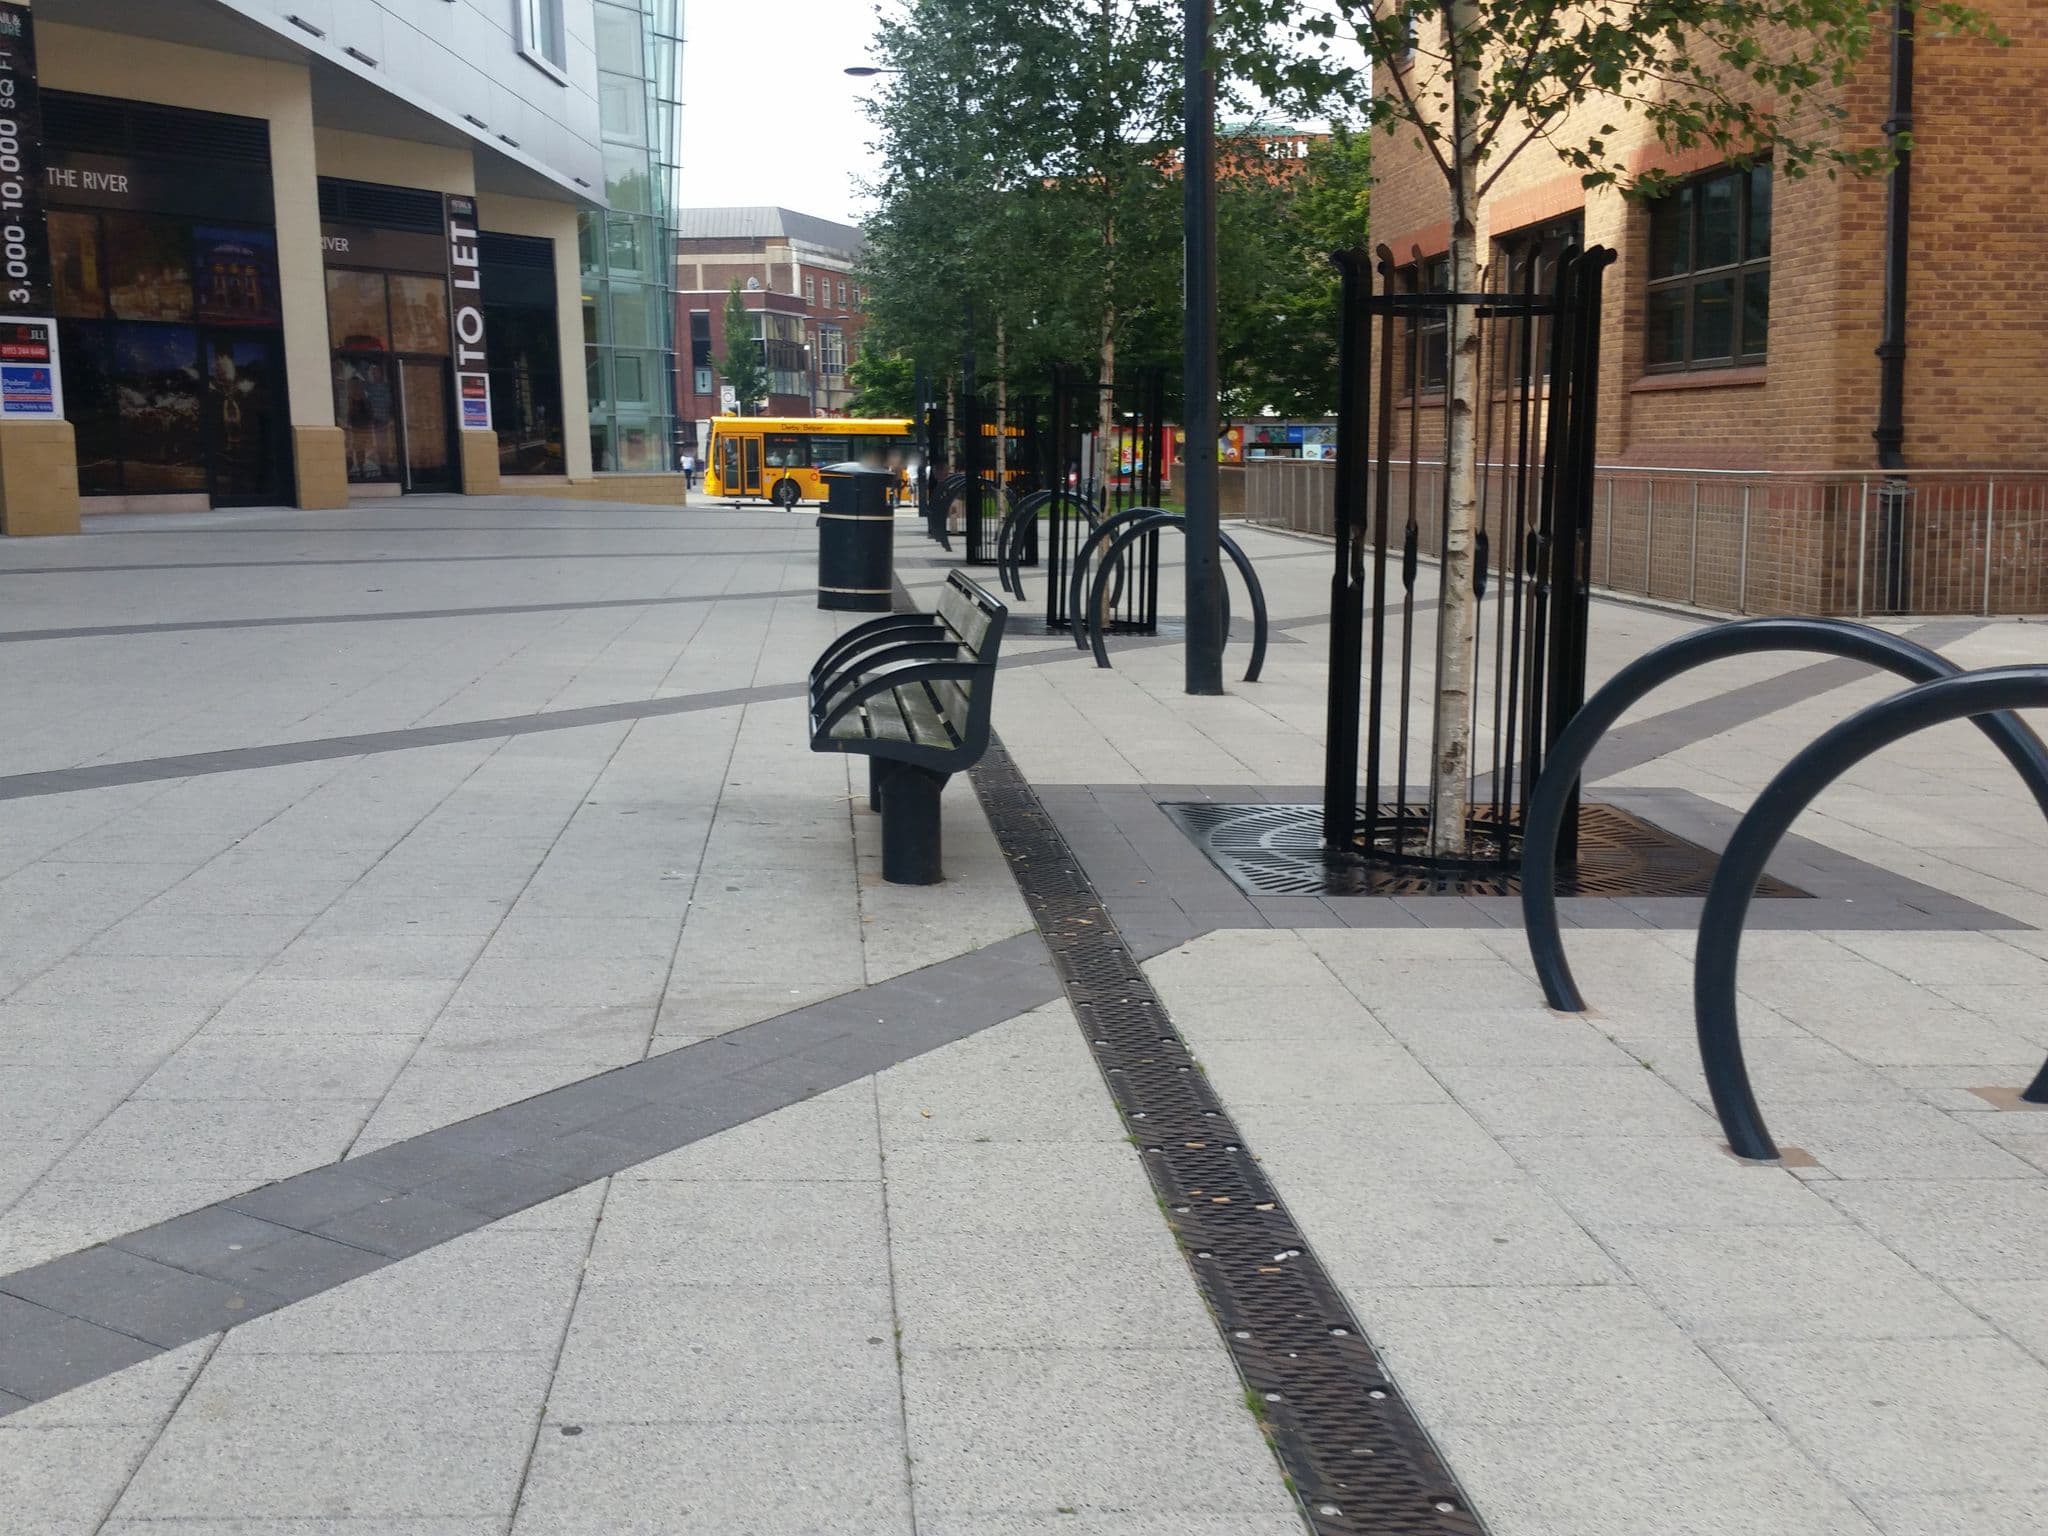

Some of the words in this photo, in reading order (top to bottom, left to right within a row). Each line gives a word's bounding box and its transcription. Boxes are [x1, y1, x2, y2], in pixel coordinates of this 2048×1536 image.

[0, 79, 16, 109] SQ
[46, 167, 78, 188] THE
[83, 171, 128, 193] RIVER
[450, 220, 480, 290] LET
[456, 306, 486, 366] TO
